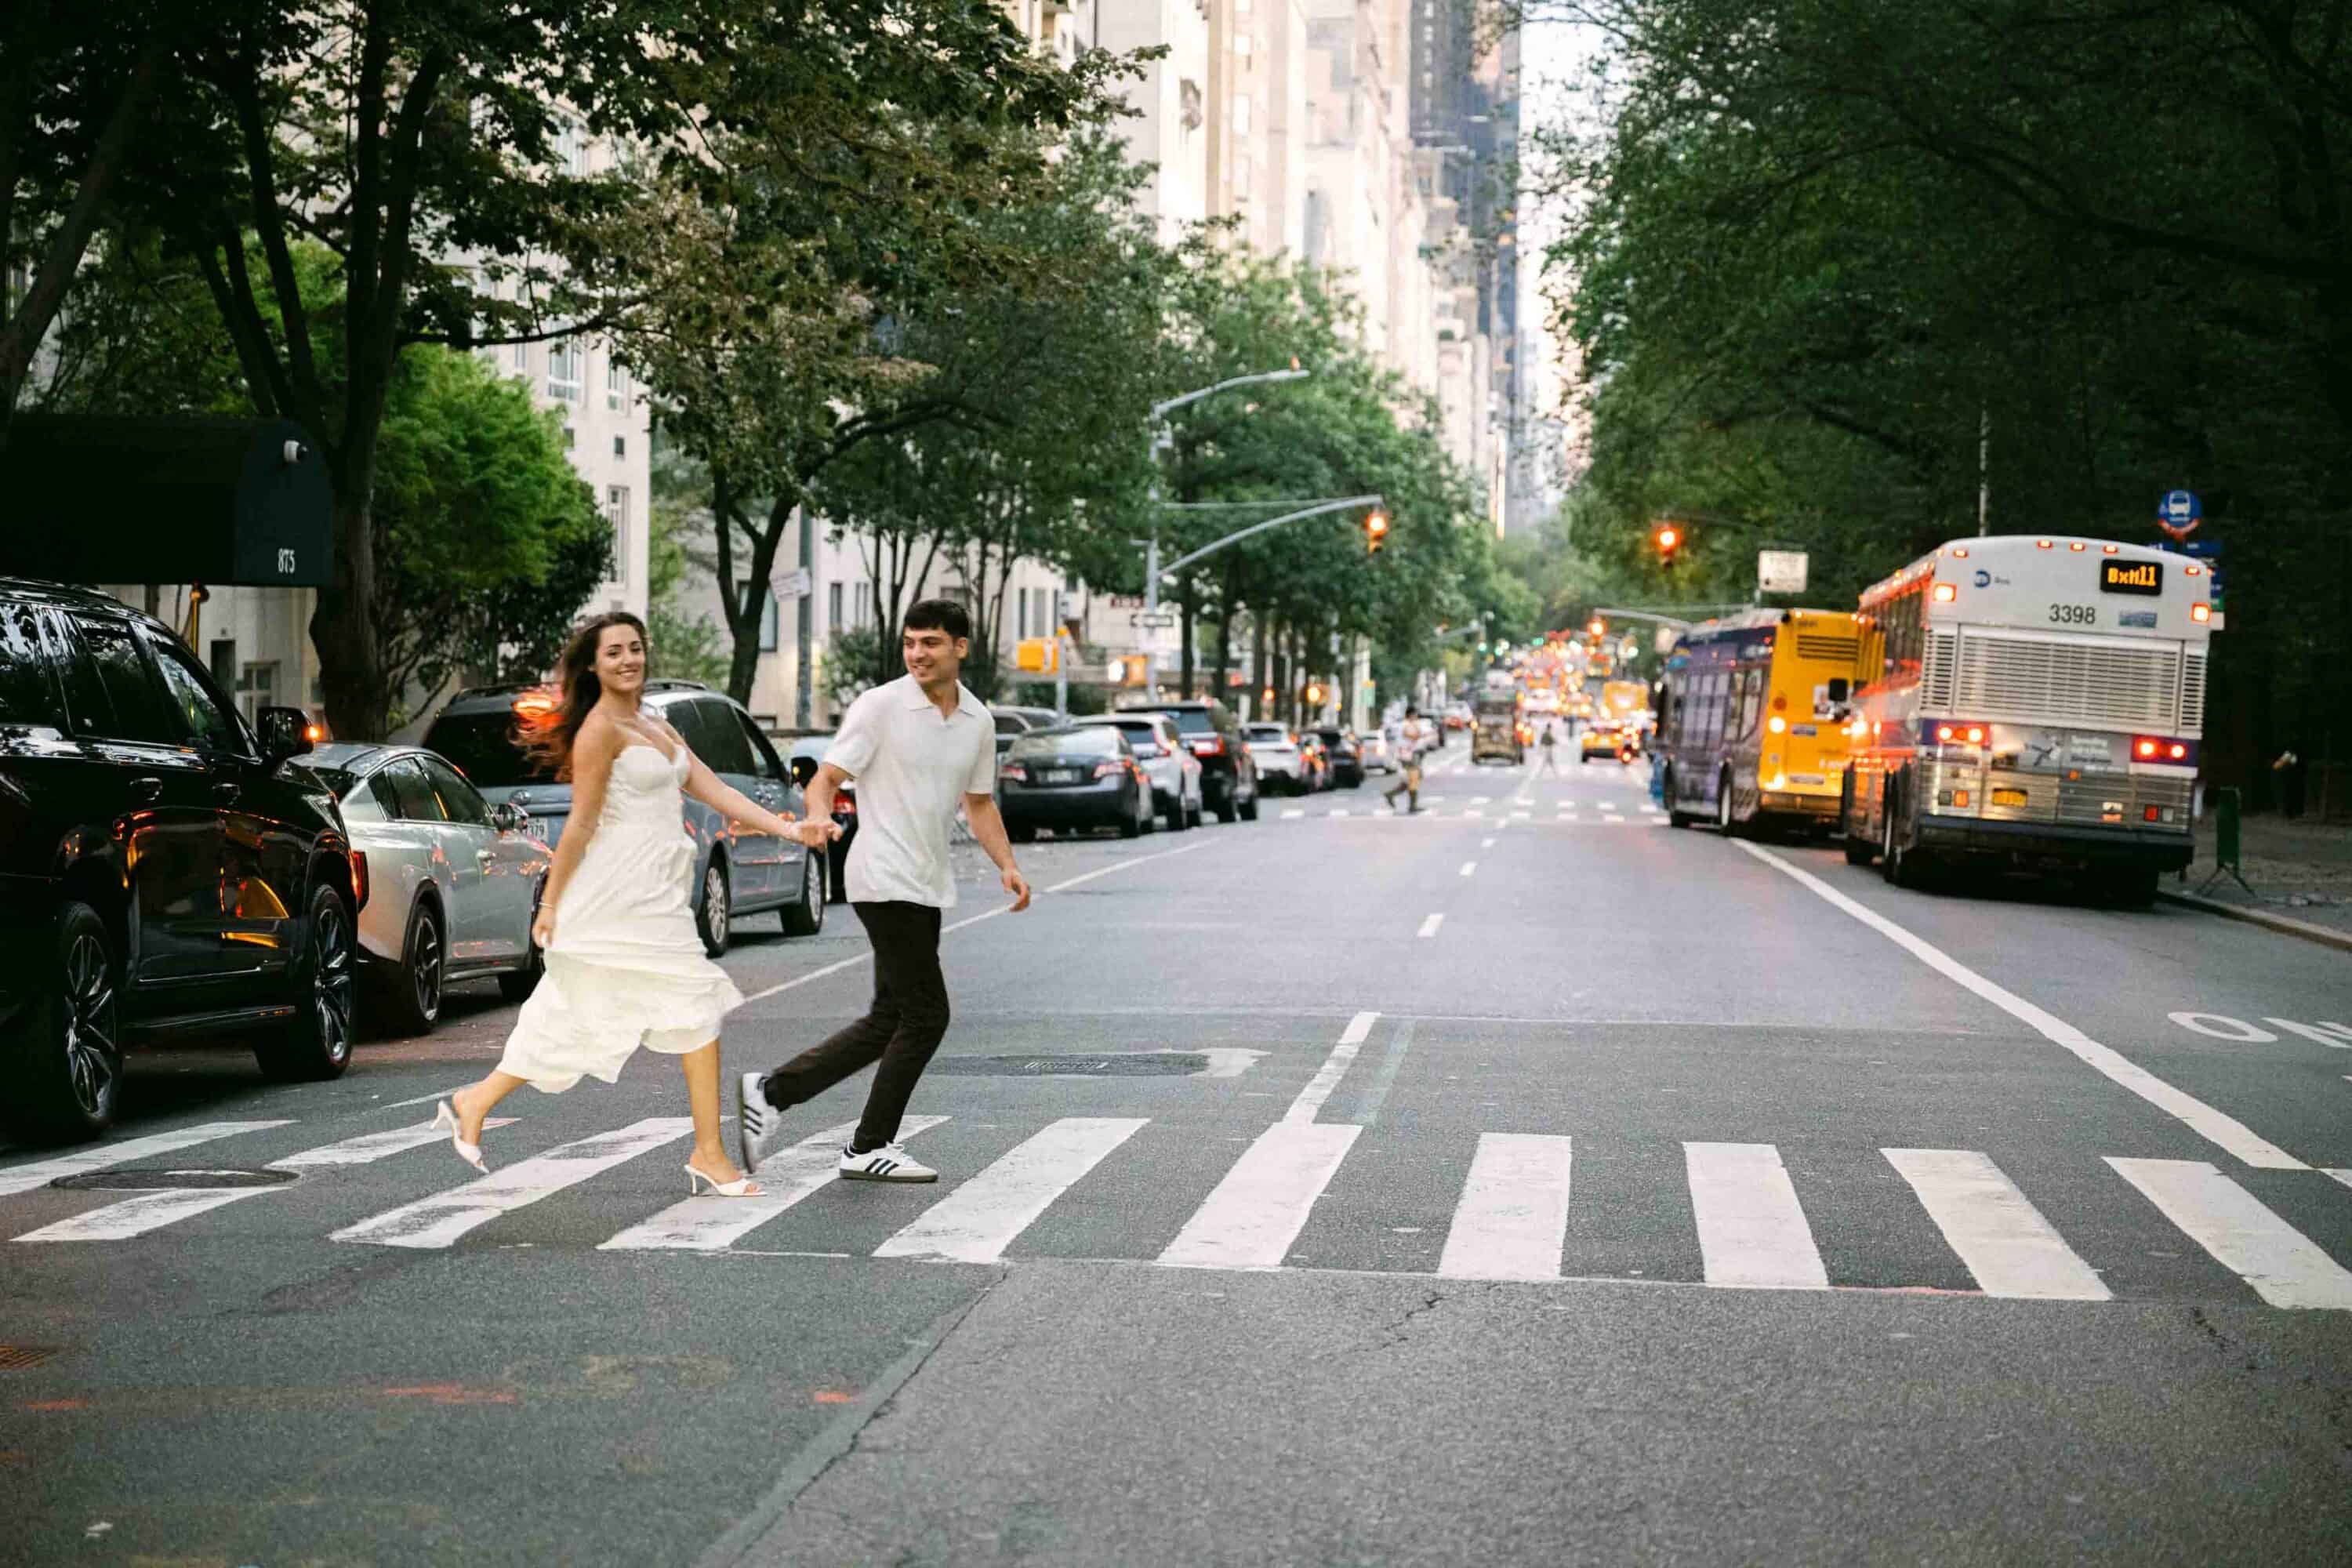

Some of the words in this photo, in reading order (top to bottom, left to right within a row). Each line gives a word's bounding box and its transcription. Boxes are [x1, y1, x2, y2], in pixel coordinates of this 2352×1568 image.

[278, 548, 296, 574] 875
[2107, 564, 2156, 586] BxM11
[2049, 603, 2096, 624] 3398
